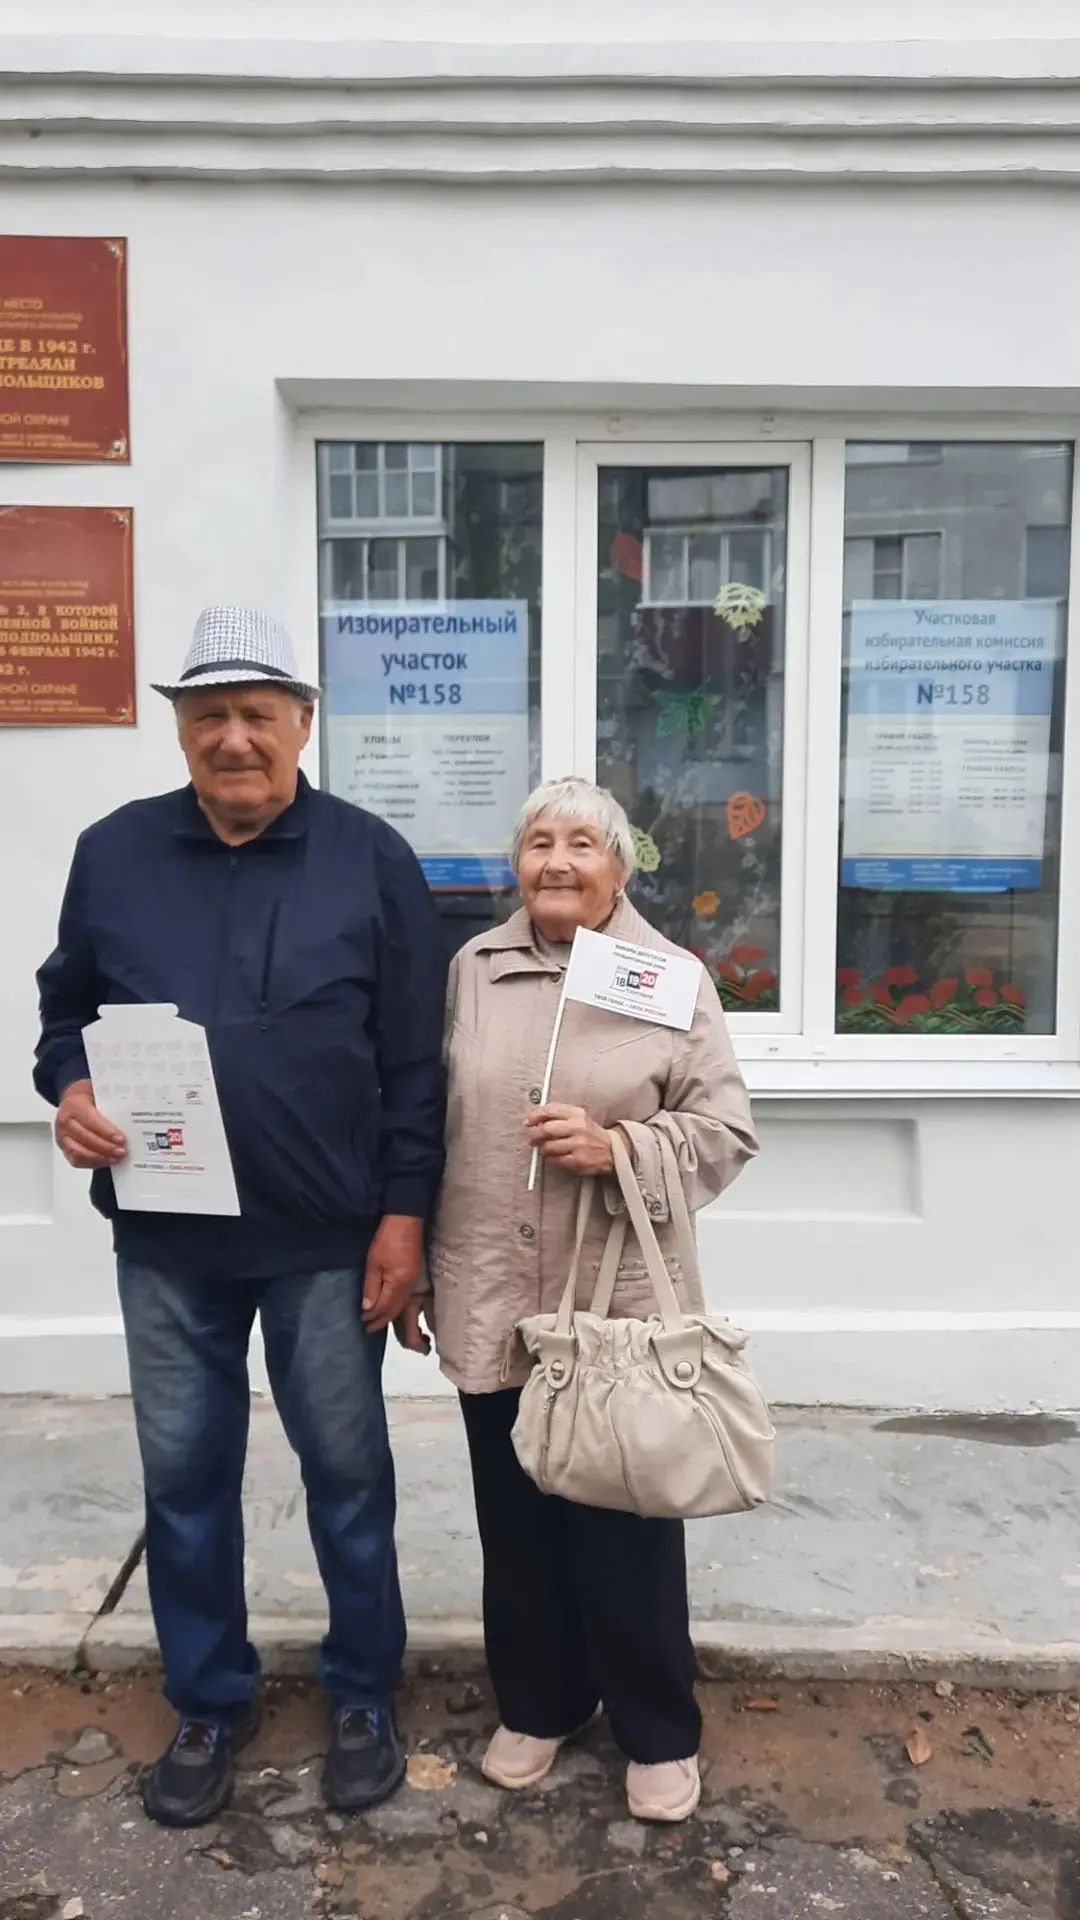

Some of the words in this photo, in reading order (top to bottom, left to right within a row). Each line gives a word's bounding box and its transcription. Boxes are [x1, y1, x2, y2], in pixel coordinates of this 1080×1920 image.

[20, 338, 32, 353] В
[38, 339, 78, 354] 1942
[55, 602, 118, 616] КОТОРОЙ
[914, 609, 997, 626] Участковая
[60, 617, 119, 630] ВОЙНОЙ
[337, 610, 518, 640] Избирательный
[865, 632, 972, 651] избирательная
[976, 635, 1045, 649] комиссия
[9, 645, 71, 657] ФЕВРАЛЯ
[75, 646, 105, 657] 1942
[381, 652, 469, 677] участок
[864, 655, 983, 675] избирательного
[987, 658, 1043, 675] участка
[389, 683, 463, 706] №158
[917, 683, 991, 706] №158
[615, 976, 626, 988] 18
[628, 973, 639, 987] 19
[640, 972, 656, 987] 20
[167, 1131, 182, 1143] 20
